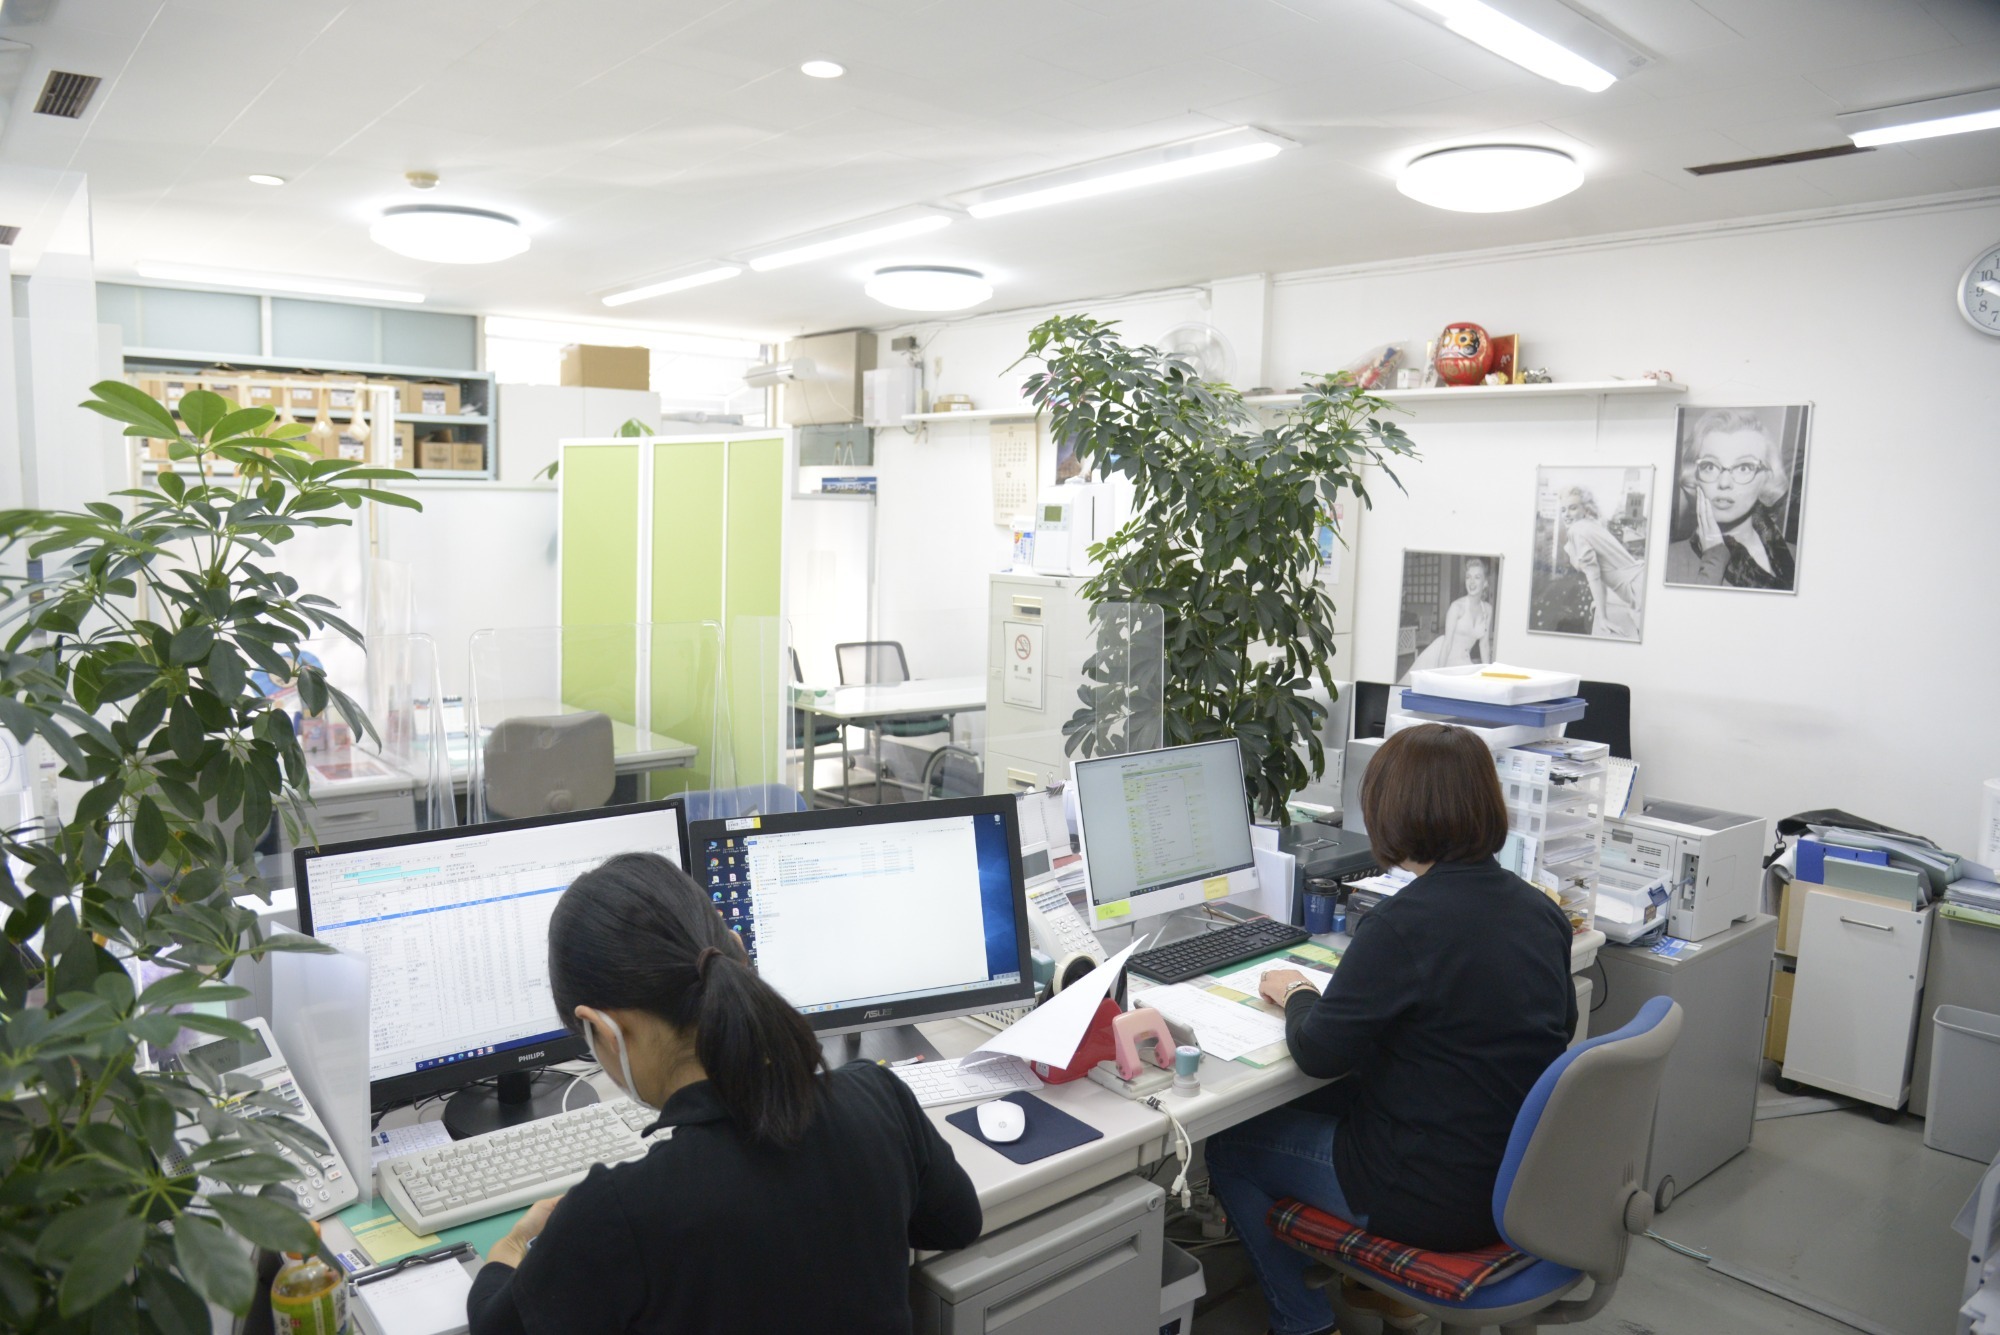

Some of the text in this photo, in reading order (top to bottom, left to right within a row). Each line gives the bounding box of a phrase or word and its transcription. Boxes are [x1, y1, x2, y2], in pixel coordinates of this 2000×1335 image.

[1981, 270, 1993, 281] 10
[1976, 286, 1984, 297] 9
[1979, 300, 1988, 312] 8
[1991, 311, 1999, 322] 7
[863, 1008, 893, 1019] ASUS
[518, 1050, 545, 1062] PHILIPS
